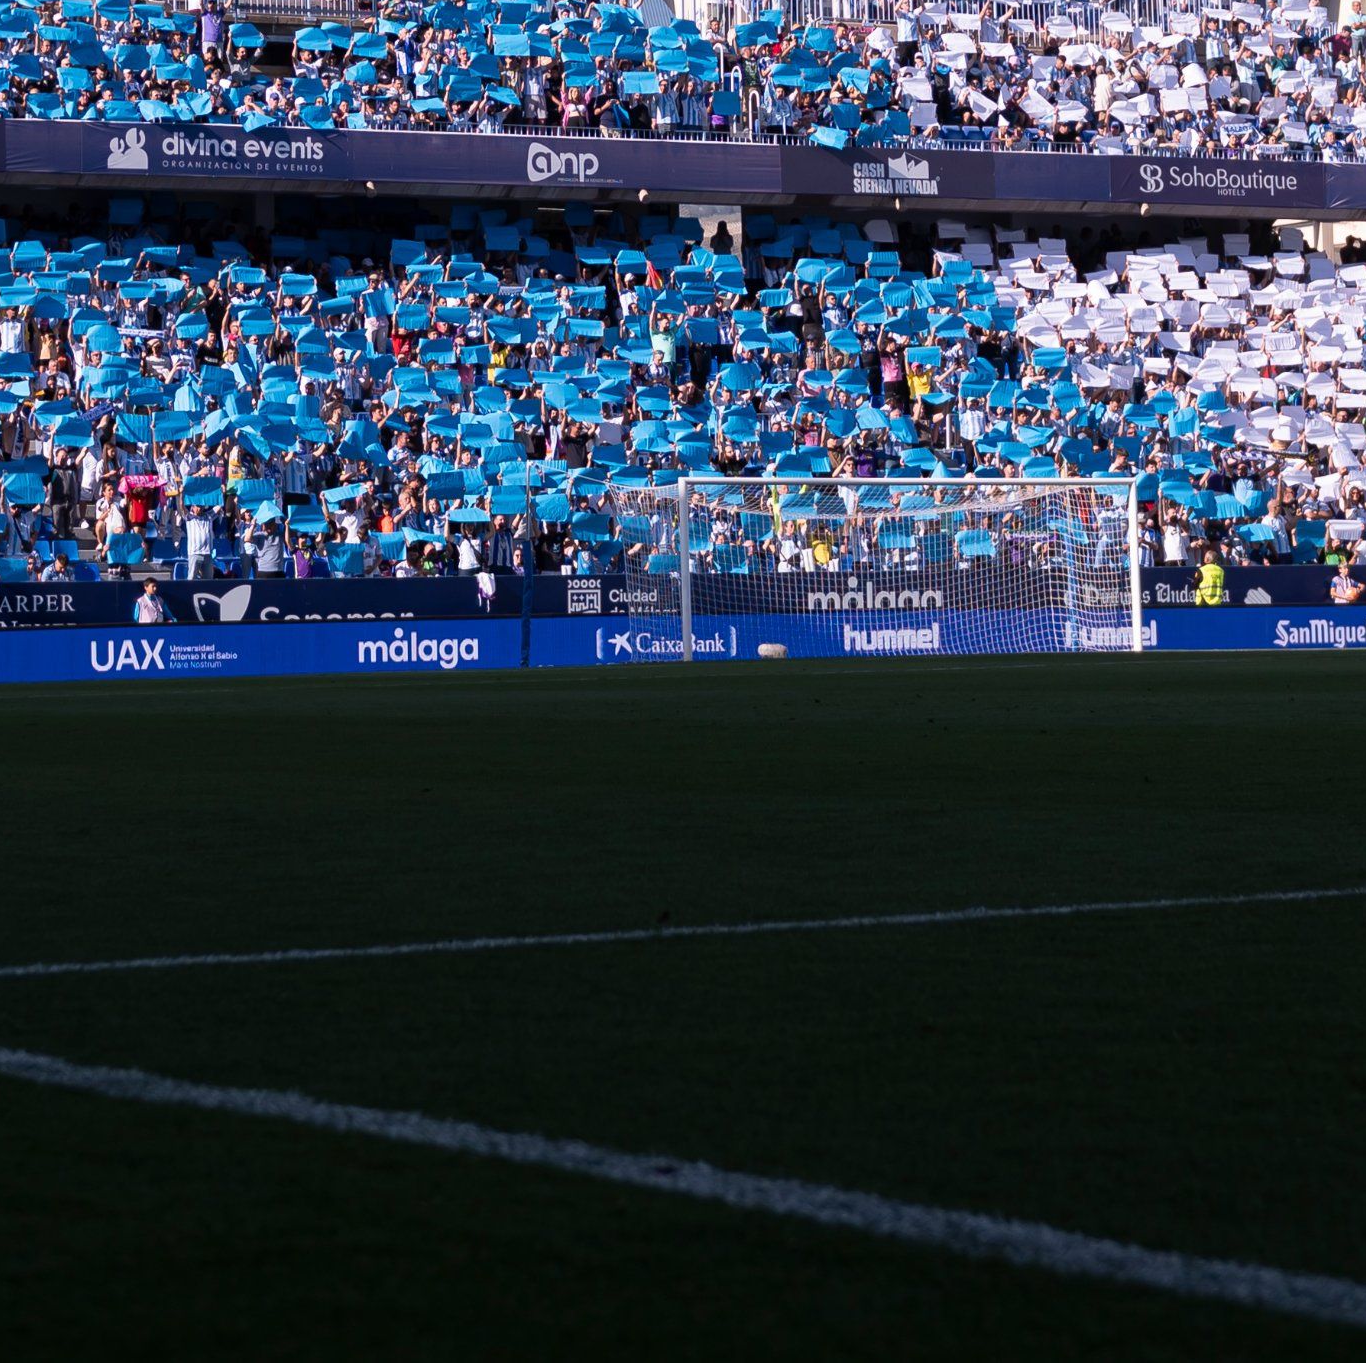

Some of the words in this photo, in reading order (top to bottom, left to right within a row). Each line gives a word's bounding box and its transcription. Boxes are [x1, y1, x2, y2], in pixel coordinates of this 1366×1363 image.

[161, 132, 236, 157] divina
[243, 136, 324, 160] events
[256, 162, 270, 171] DE
[276, 163, 324, 173] EVENTOS
[531, 152, 599, 182] anp
[853, 163, 885, 178] CASH
[853, 178, 893, 194] SIERRA
[895, 179, 939, 195] NEVADA
[1169, 166, 1297, 196] SohoBoutique
[609, 588, 657, 604] Ciudad
[844, 623, 939, 651] hummel
[91, 639, 165, 671] UAX
[170, 644, 215, 652] Universidad
[170, 652, 199, 660] Alfonso
